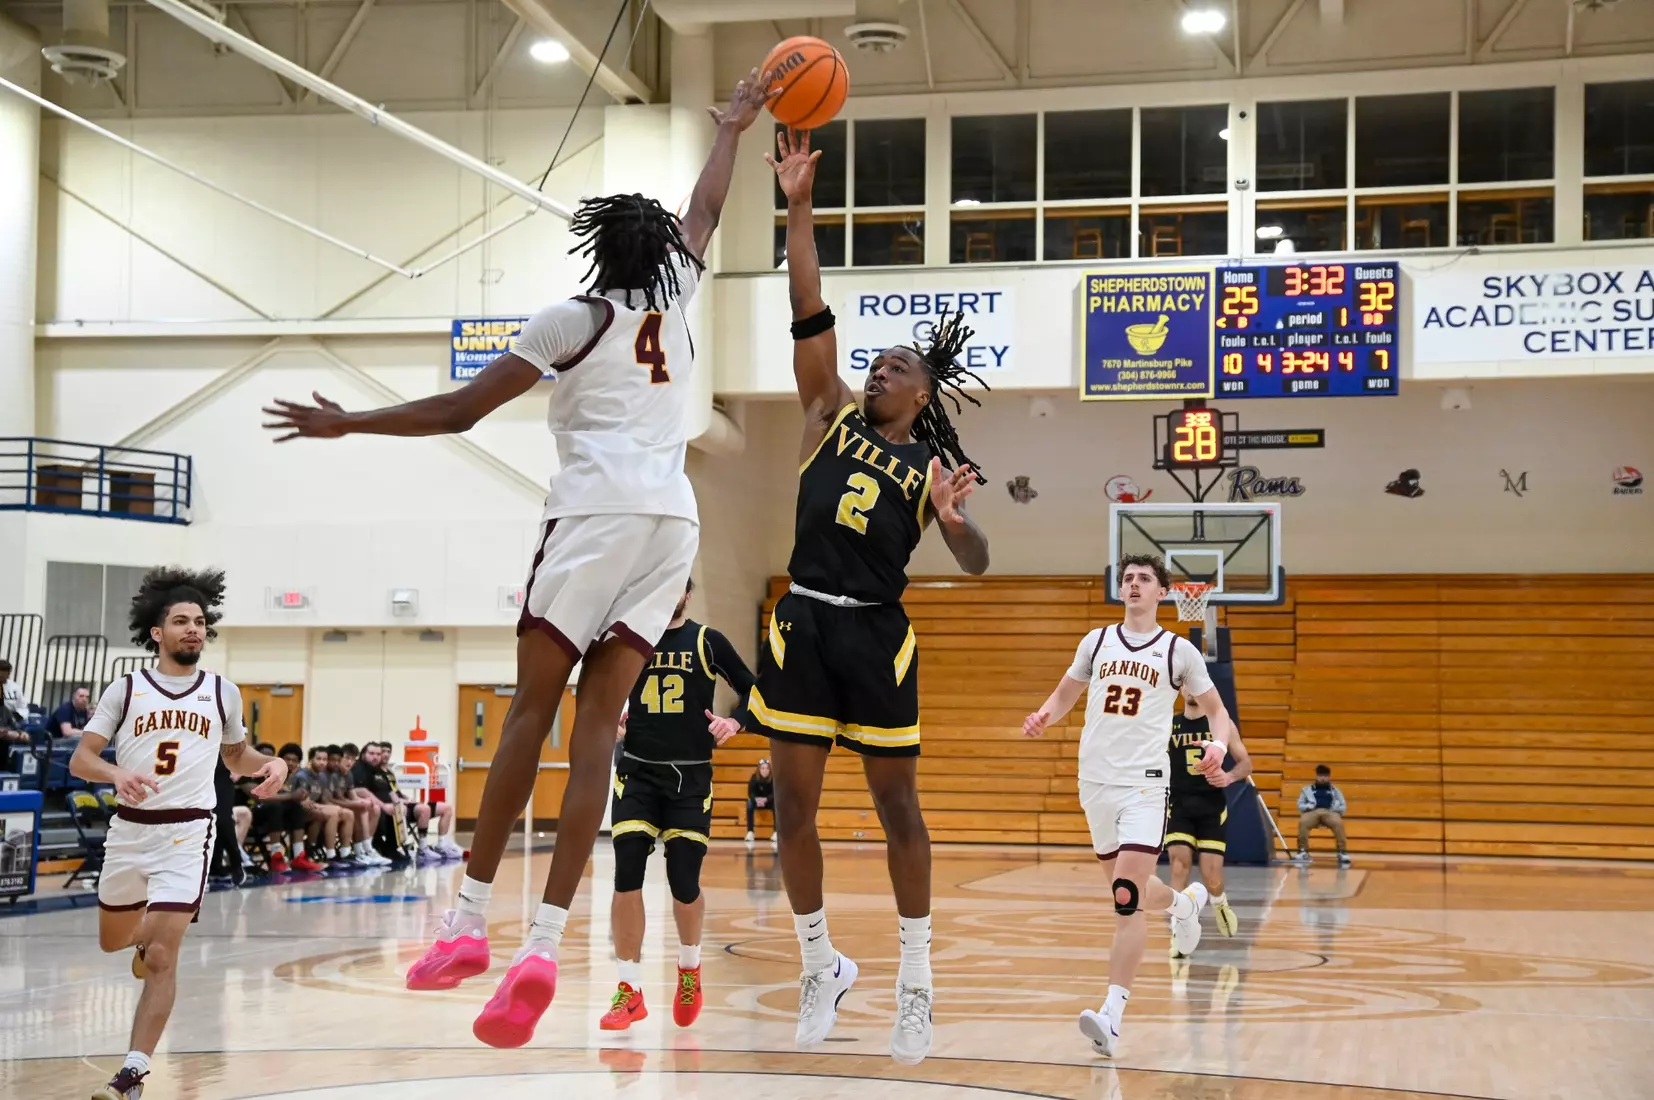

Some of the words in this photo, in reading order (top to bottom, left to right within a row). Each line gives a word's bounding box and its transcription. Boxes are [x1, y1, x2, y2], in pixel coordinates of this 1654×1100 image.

[1223, 271, 1254, 284] Home
[1285, 265, 1345, 296] 3:32
[1355, 267, 1394, 280] Guests
[1090, 276, 1206, 293] SHEPHERDSTOWN
[1483, 271, 1624, 298] SKYBOX
[859, 292, 1002, 316] ROBERT
[1090, 294, 1204, 313] PHARMACY
[1223, 286, 1258, 315] 25
[1360, 282, 1395, 312] 32
[1288, 312, 1323, 328] period
[1341, 307, 1347, 327] 1
[634, 311, 671, 385] 4
[1221, 335, 1246, 347] fouls
[1288, 332, 1323, 347] player
[1365, 331, 1392, 345] fouls
[1124, 358, 1172, 369] Martinsburg
[1174, 358, 1193, 367] Pike
[1223, 353, 1242, 375] 10
[1257, 353, 1271, 373] 4
[1282, 351, 1330, 374] 3-24
[1338, 352, 1353, 371] 4
[1375, 349, 1388, 370] 7
[1118, 371, 1138, 381] (304)
[1223, 381, 1244, 391] won
[1292, 380, 1319, 393] game
[1368, 378, 1390, 389] won
[1090, 382, 1205, 392] www.shepherdstownrx.com
[1174, 426, 1216, 460] 28
[1228, 466, 1305, 503] Rams
[835, 472, 881, 535] 2
[1100, 660, 1160, 688] GANNON
[641, 674, 684, 713] 42
[1103, 684, 1142, 717] 23
[134, 710, 211, 740] GANNON
[154, 740, 180, 776] 5
[1186, 749, 1202, 775] 5
